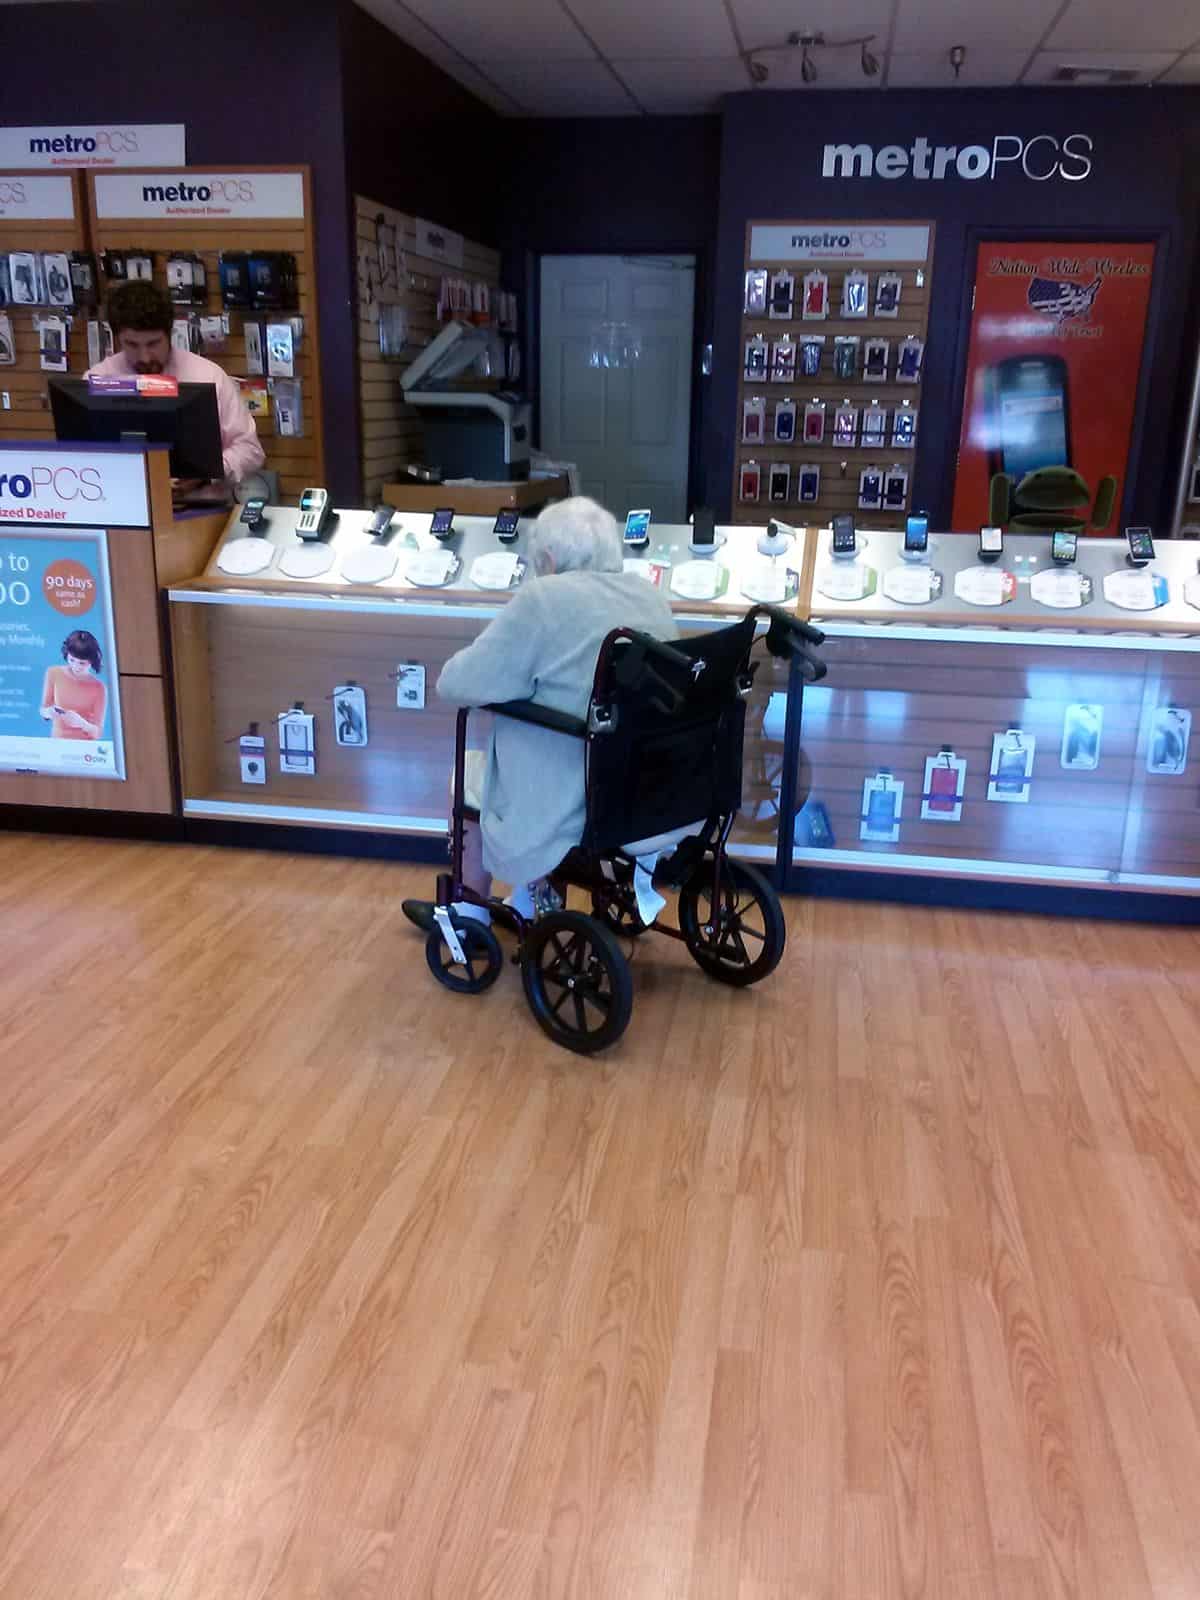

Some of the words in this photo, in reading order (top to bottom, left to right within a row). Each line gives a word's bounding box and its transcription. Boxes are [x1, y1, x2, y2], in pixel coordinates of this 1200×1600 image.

[30, 131, 139, 152] metroPCS
[821, 134, 1093, 181] metroPCS
[143, 179, 254, 202] metroPCS
[791, 231, 886, 248] metroPCS
[988, 256, 1039, 275] Nation
[26, 507, 67, 520] Dealer
[8, 552, 29, 572] to
[45, 575, 65, 590] 90
[66, 575, 94, 592] days
